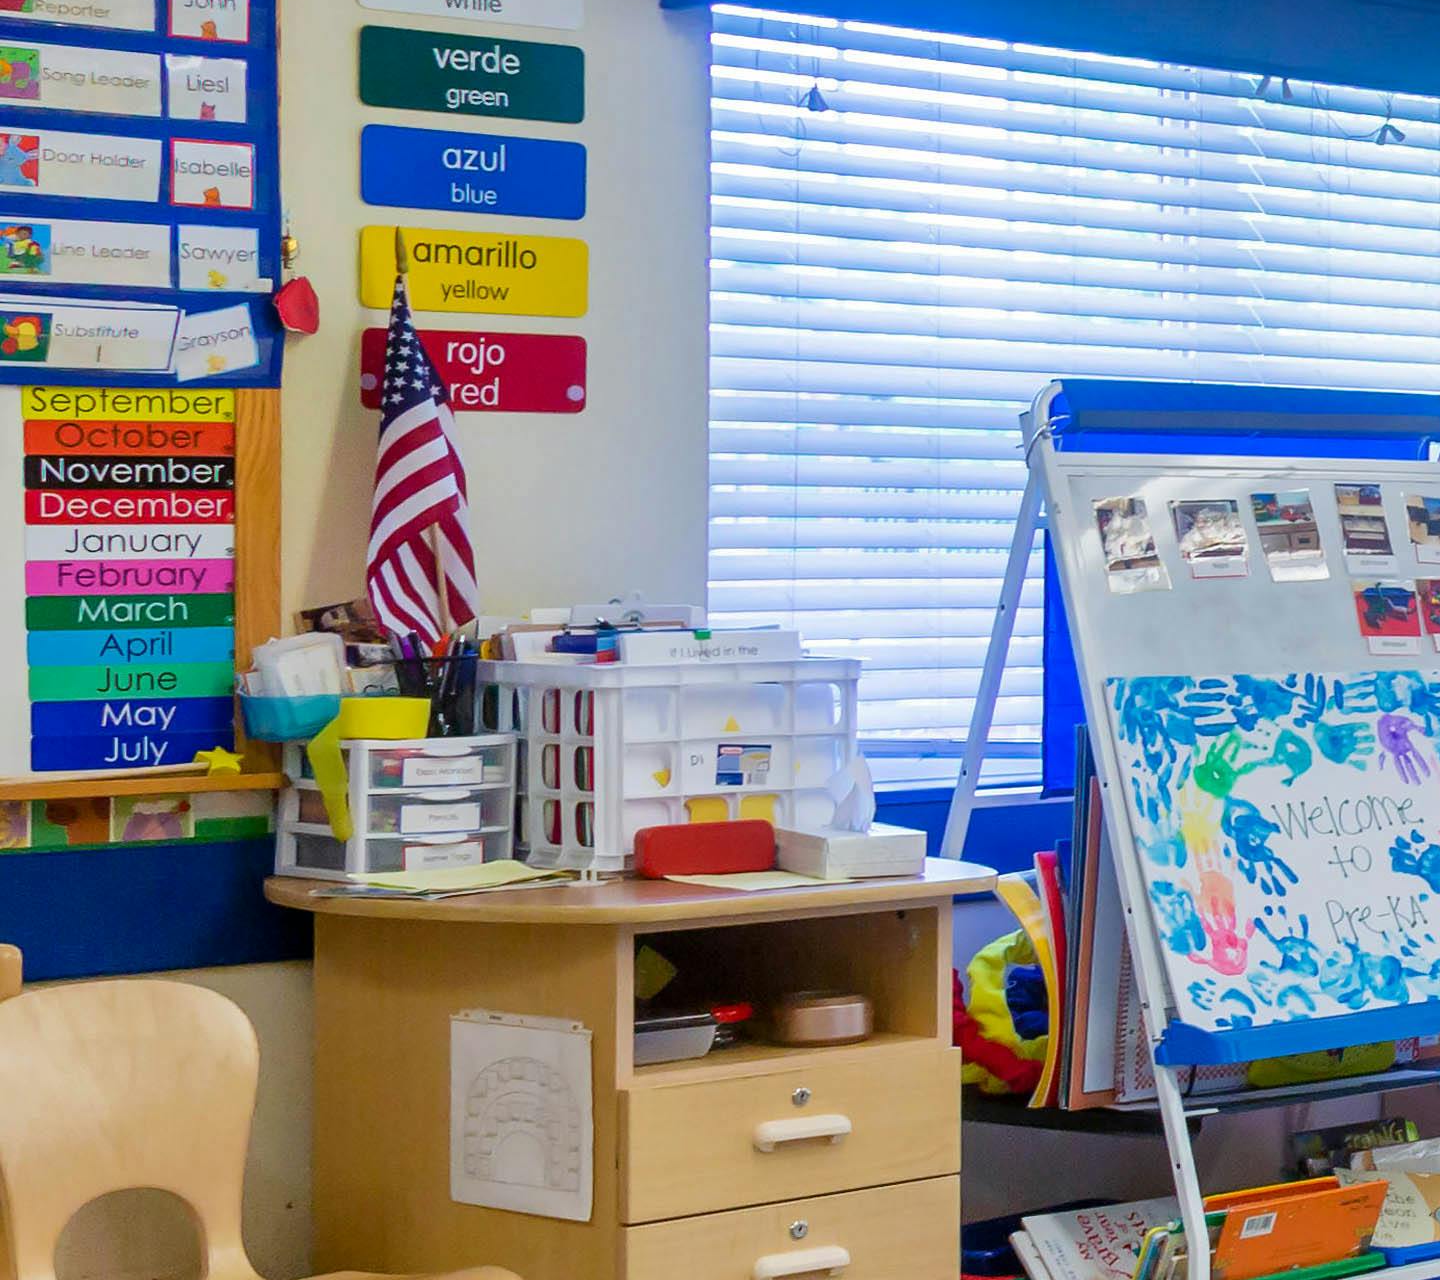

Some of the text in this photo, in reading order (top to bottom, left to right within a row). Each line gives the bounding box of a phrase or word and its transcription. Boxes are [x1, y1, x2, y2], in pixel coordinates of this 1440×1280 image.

[35, 0, 110, 19] Reporter
[432, 45, 521, 75] verde
[42, 68, 150, 89] Song Leader
[187, 75, 229, 93] Liesl
[446, 88, 509, 109] green
[43, 149, 147, 169] Door Holder
[174, 158, 250, 178] Isabelle
[442, 144, 506, 172] azul
[451, 182, 498, 205] blue
[52, 242, 150, 260] Line Leader
[180, 243, 256, 264] Sawyer
[413, 241, 537, 270] amarillo
[441, 280, 509, 303] yellow
[54, 323, 140, 339] Substitute
[446, 337, 506, 375] rojo
[30, 387, 225, 417] September
[449, 378, 500, 406] red
[55, 422, 203, 449] October
[40, 458, 225, 484] November
[40, 492, 227, 519] December
[65, 529, 202, 557] January
[57, 563, 206, 591] February
[77, 597, 189, 623] March
[100, 632, 173, 661] April
[738, 646, 758, 656] the
[96, 666, 178, 691] June
[101, 703, 176, 728] May
[104, 735, 169, 766] July
[1271, 795, 1424, 840] Welcome
[1328, 845, 1372, 878] to
